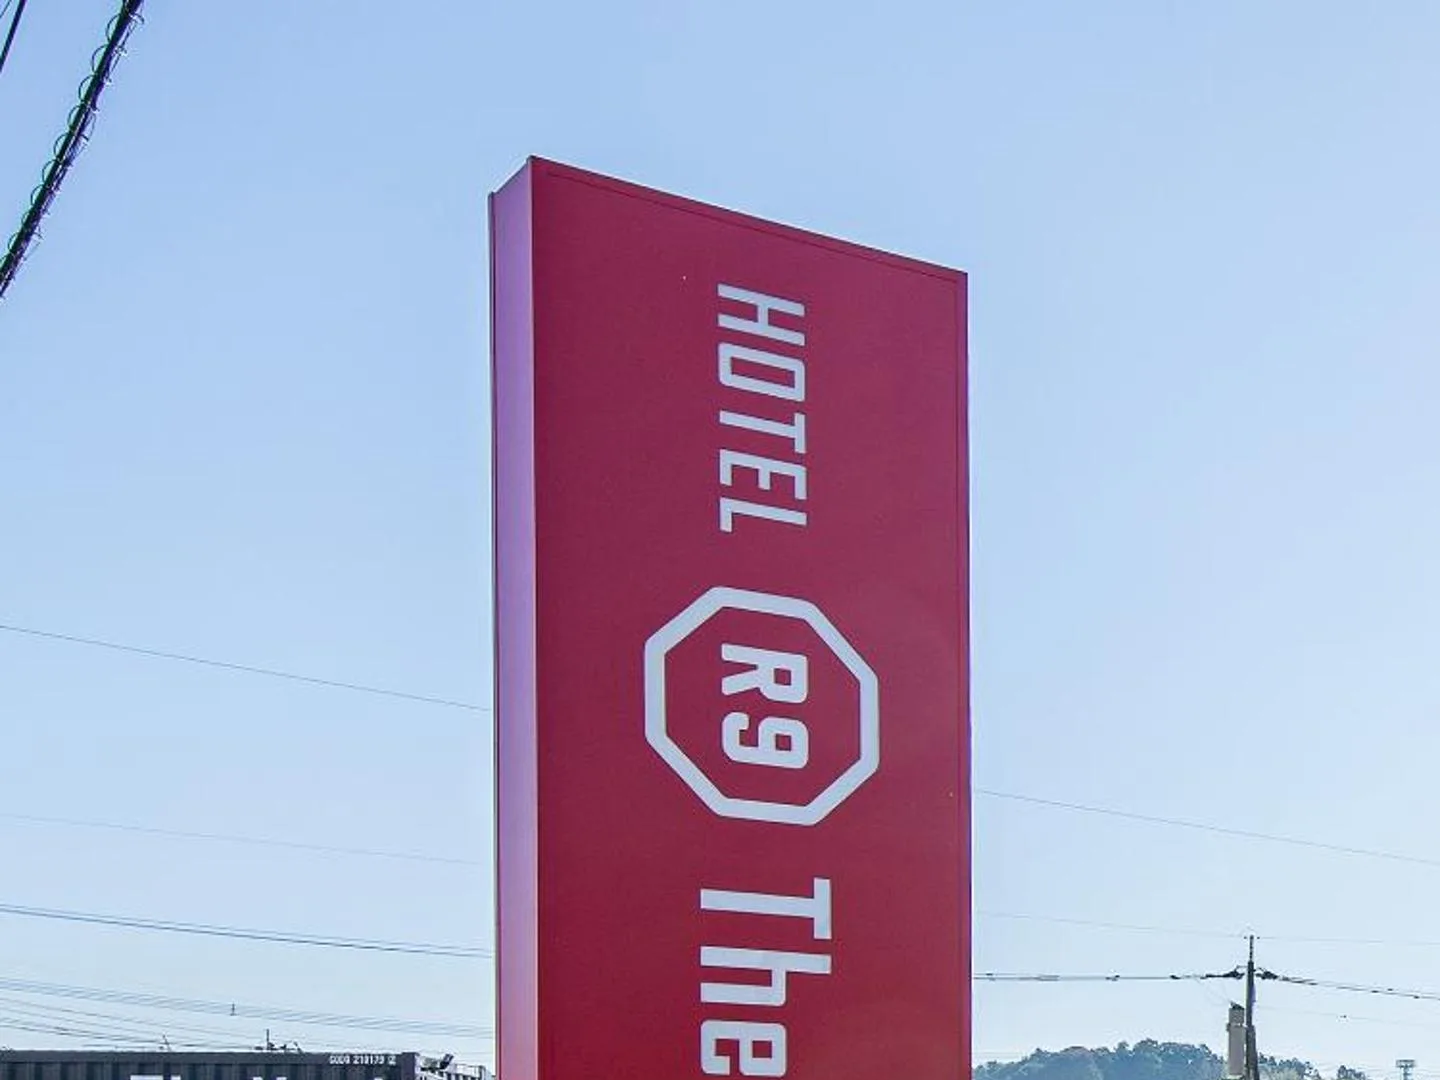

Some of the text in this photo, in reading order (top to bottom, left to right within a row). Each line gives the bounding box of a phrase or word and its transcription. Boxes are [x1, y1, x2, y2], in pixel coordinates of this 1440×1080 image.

[719, 284, 806, 532] HOTEL
[722, 643, 808, 769] R9
[700, 877, 832, 1077] The
